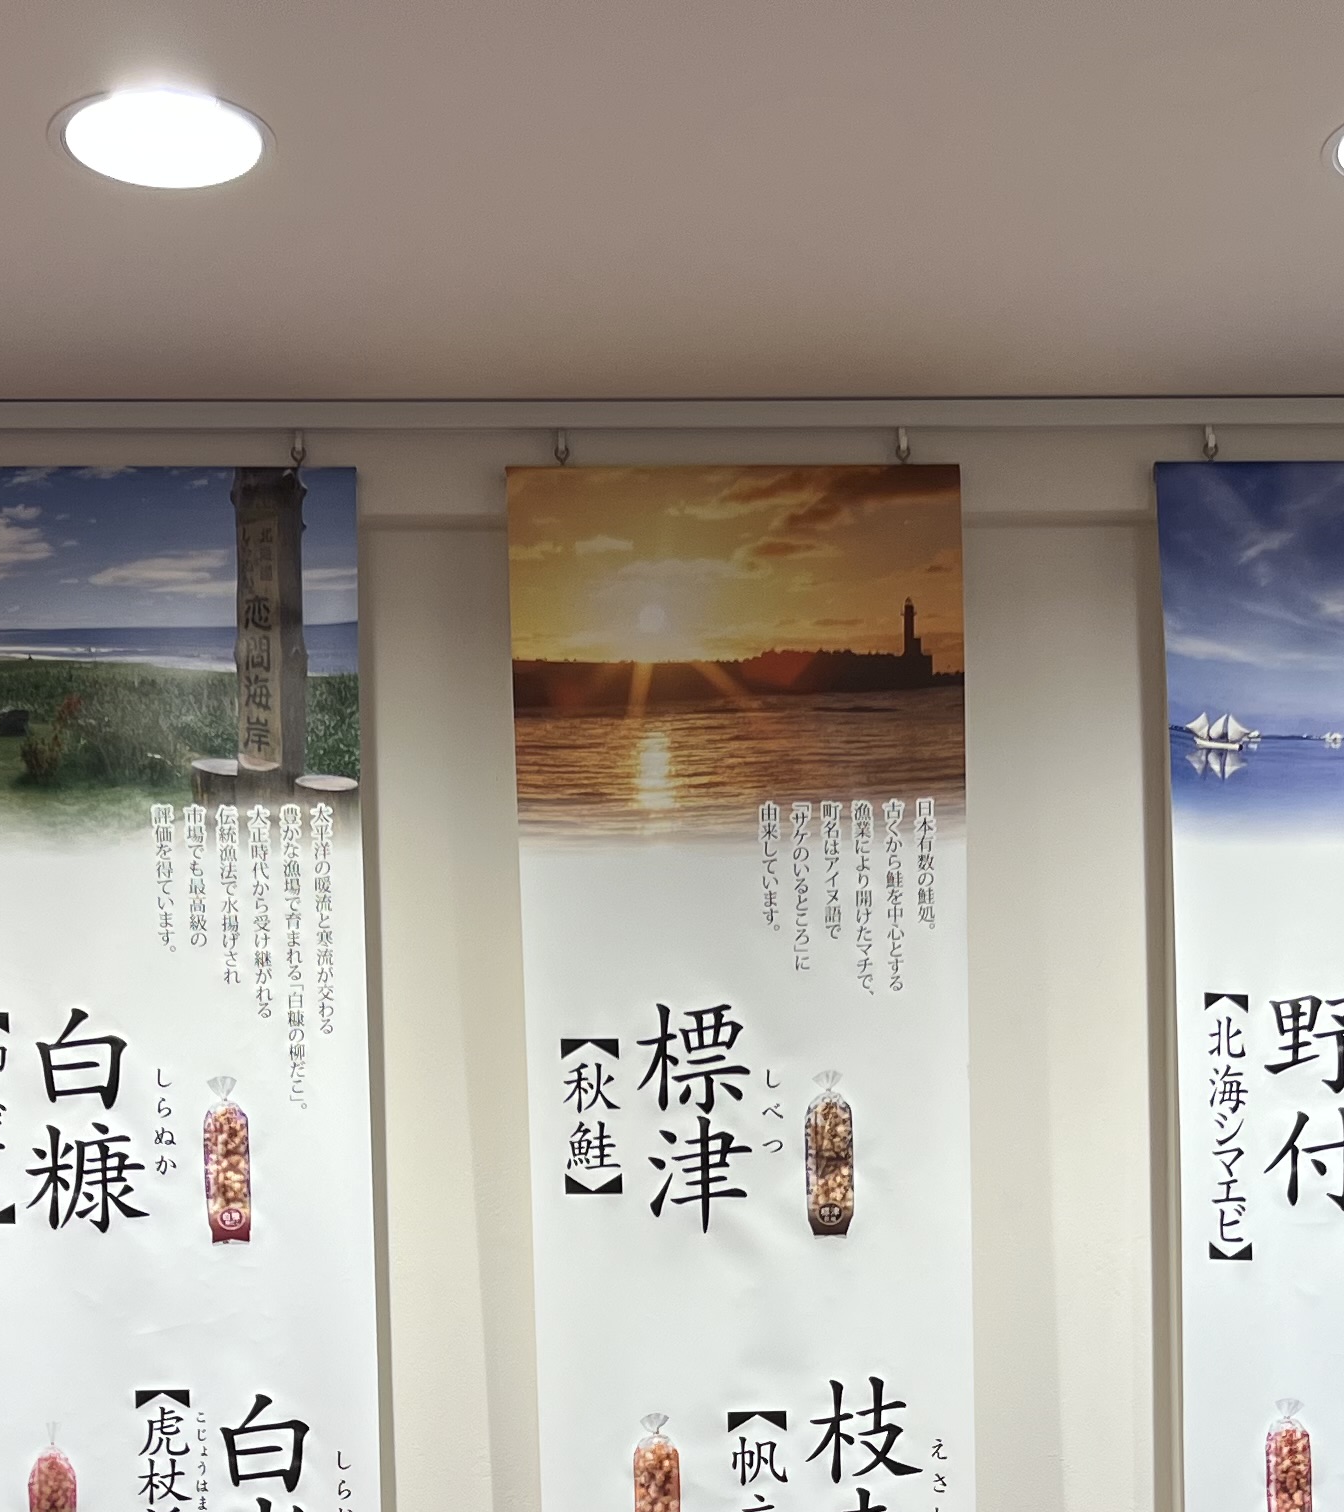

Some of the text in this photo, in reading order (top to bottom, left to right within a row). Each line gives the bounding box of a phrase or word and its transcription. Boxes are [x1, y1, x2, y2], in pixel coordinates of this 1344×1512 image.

[154, 806, 177, 952] 評価を得ています。
[186, 806, 207, 948] 市場でも最高級の
[218, 806, 241, 984] 伝統漁法で水揚げされ
[250, 806, 272, 1020] 大正時代から受け継がれる
[313, 804, 334, 1035] 太平洋の暖流と寒流が交わる
[760, 803, 780, 932] 由来しています。
[792, 803, 810, 970] 「サケのいるところ」に
[822, 801, 841, 940] 町名はアイヌ語で
[853, 800, 874, 994] 漁業により開けたマチで、
[884, 799, 904, 991] 古くから鮭を中心とする
[916, 799, 935, 929] 日本有数の鮭処。
[281, 806, 307, 1109] 豊かな漁場で育まれる「白糠の柳だこ」。
[26, 1008, 149, 1233] 白糠
[153, 1068, 177, 1175] しらぬか
[560, 1038, 623, 1194] 【秋鮭】
[636, 1003, 752, 1233] 標津
[762, 1069, 783, 1152] しべつ
[1204, 992, 1253, 1261] 【北海シマエビ】
[196, 1412, 207, 1510] こじょうはま
